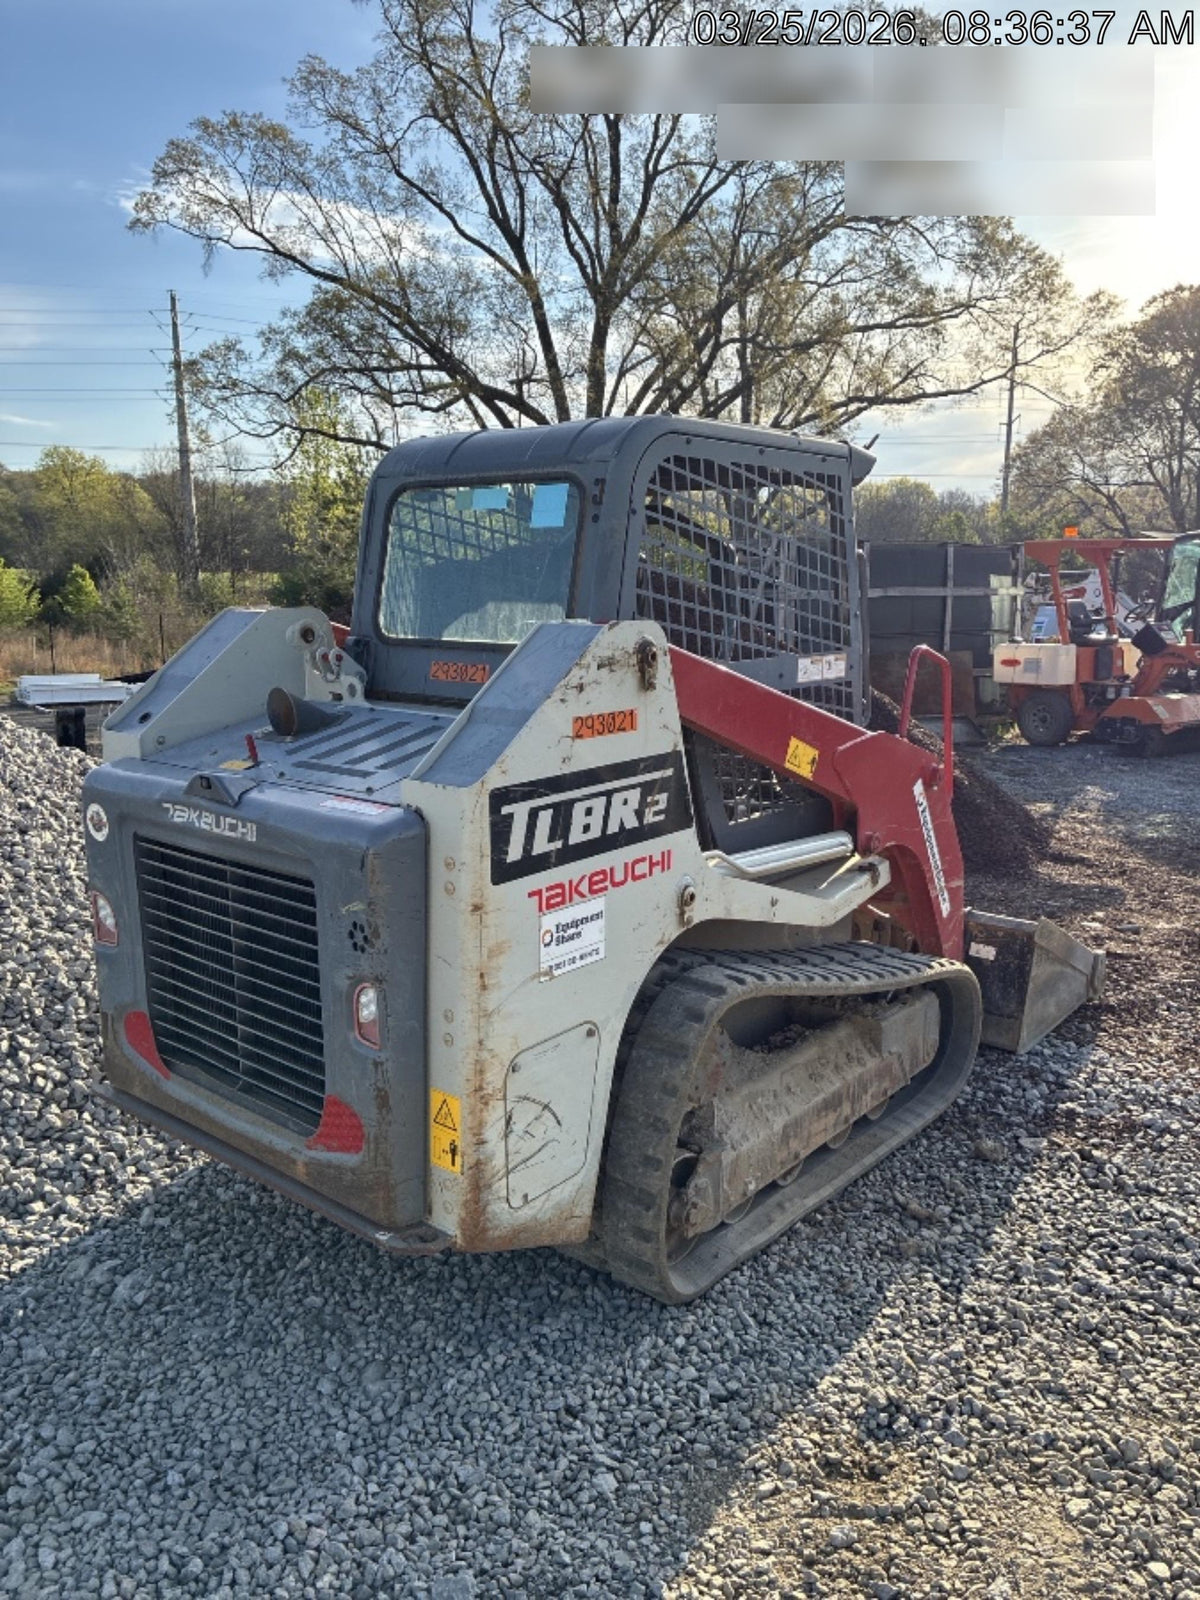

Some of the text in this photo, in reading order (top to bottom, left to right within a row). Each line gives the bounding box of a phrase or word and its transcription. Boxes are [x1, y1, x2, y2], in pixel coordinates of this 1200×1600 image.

[431, 661, 487, 682] 293021
[573, 709, 637, 738] 293021
[162, 803, 257, 842] TAKEUCHI
[528, 850, 672, 914] TAKEUCHI
